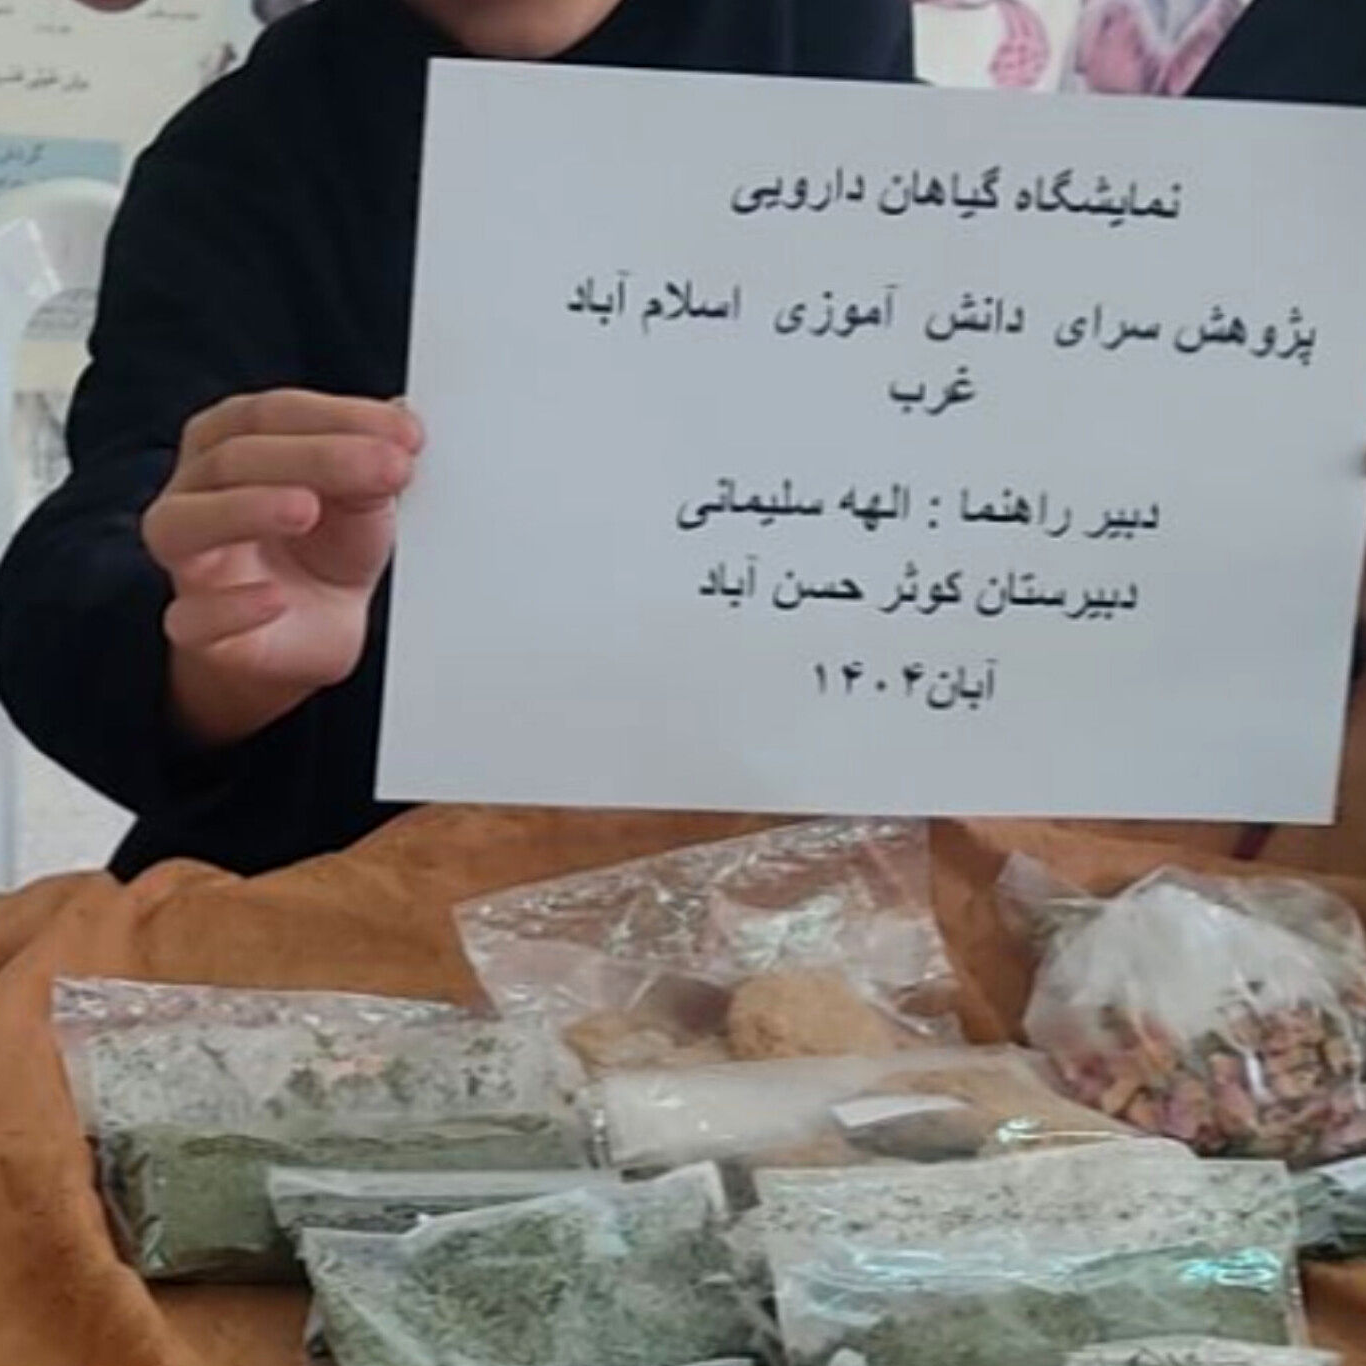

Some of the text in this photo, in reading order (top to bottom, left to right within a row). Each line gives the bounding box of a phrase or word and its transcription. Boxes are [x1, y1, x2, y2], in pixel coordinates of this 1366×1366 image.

[730, 165, 1183, 229] نمایشگاه گیاهان دارویی
[566, 270, 1317, 367] پژوهش سرای دانش آموزی اسلام آباد
[888, 365, 976, 417] غرب
[675, 477, 825, 532] سلیمانی
[837, 482, 911, 533] الهه
[959, 486, 1073, 540] راهنما
[1082, 502, 1160, 541] دبیر
[697, 554, 1139, 621] دبیرستان کوثر حسن آباد
